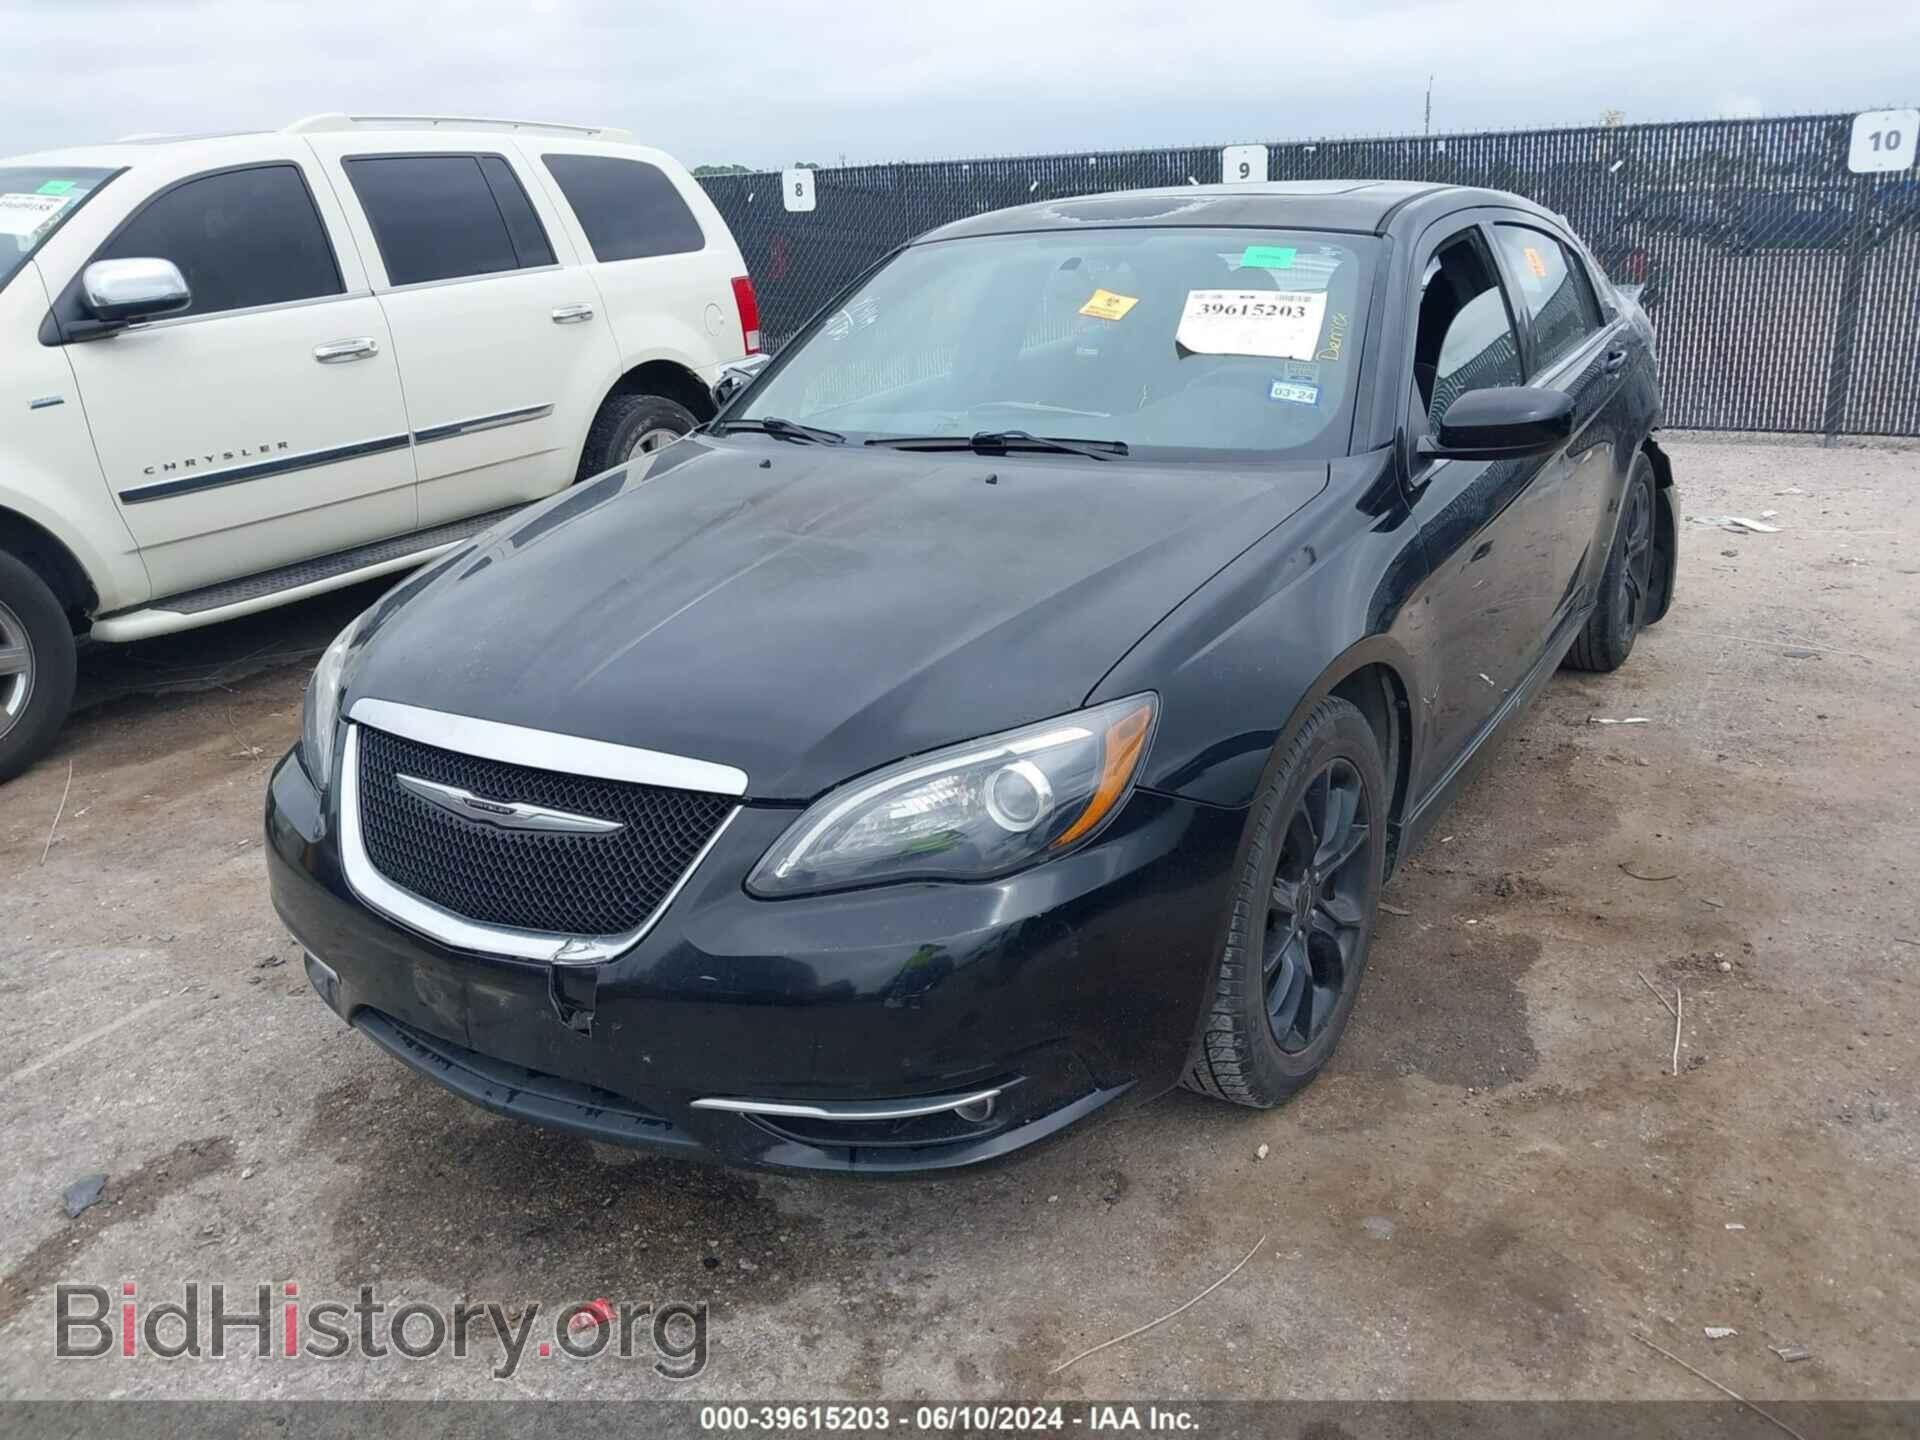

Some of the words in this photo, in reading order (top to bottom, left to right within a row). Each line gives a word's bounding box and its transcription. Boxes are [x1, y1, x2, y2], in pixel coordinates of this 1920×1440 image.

[1869, 130, 1901, 151] 10
[1239, 162, 1250, 179] 9
[795, 182, 803, 197] 8
[1196, 303, 1306, 317] 39615203
[143, 441, 288, 475] CHRYSLER
